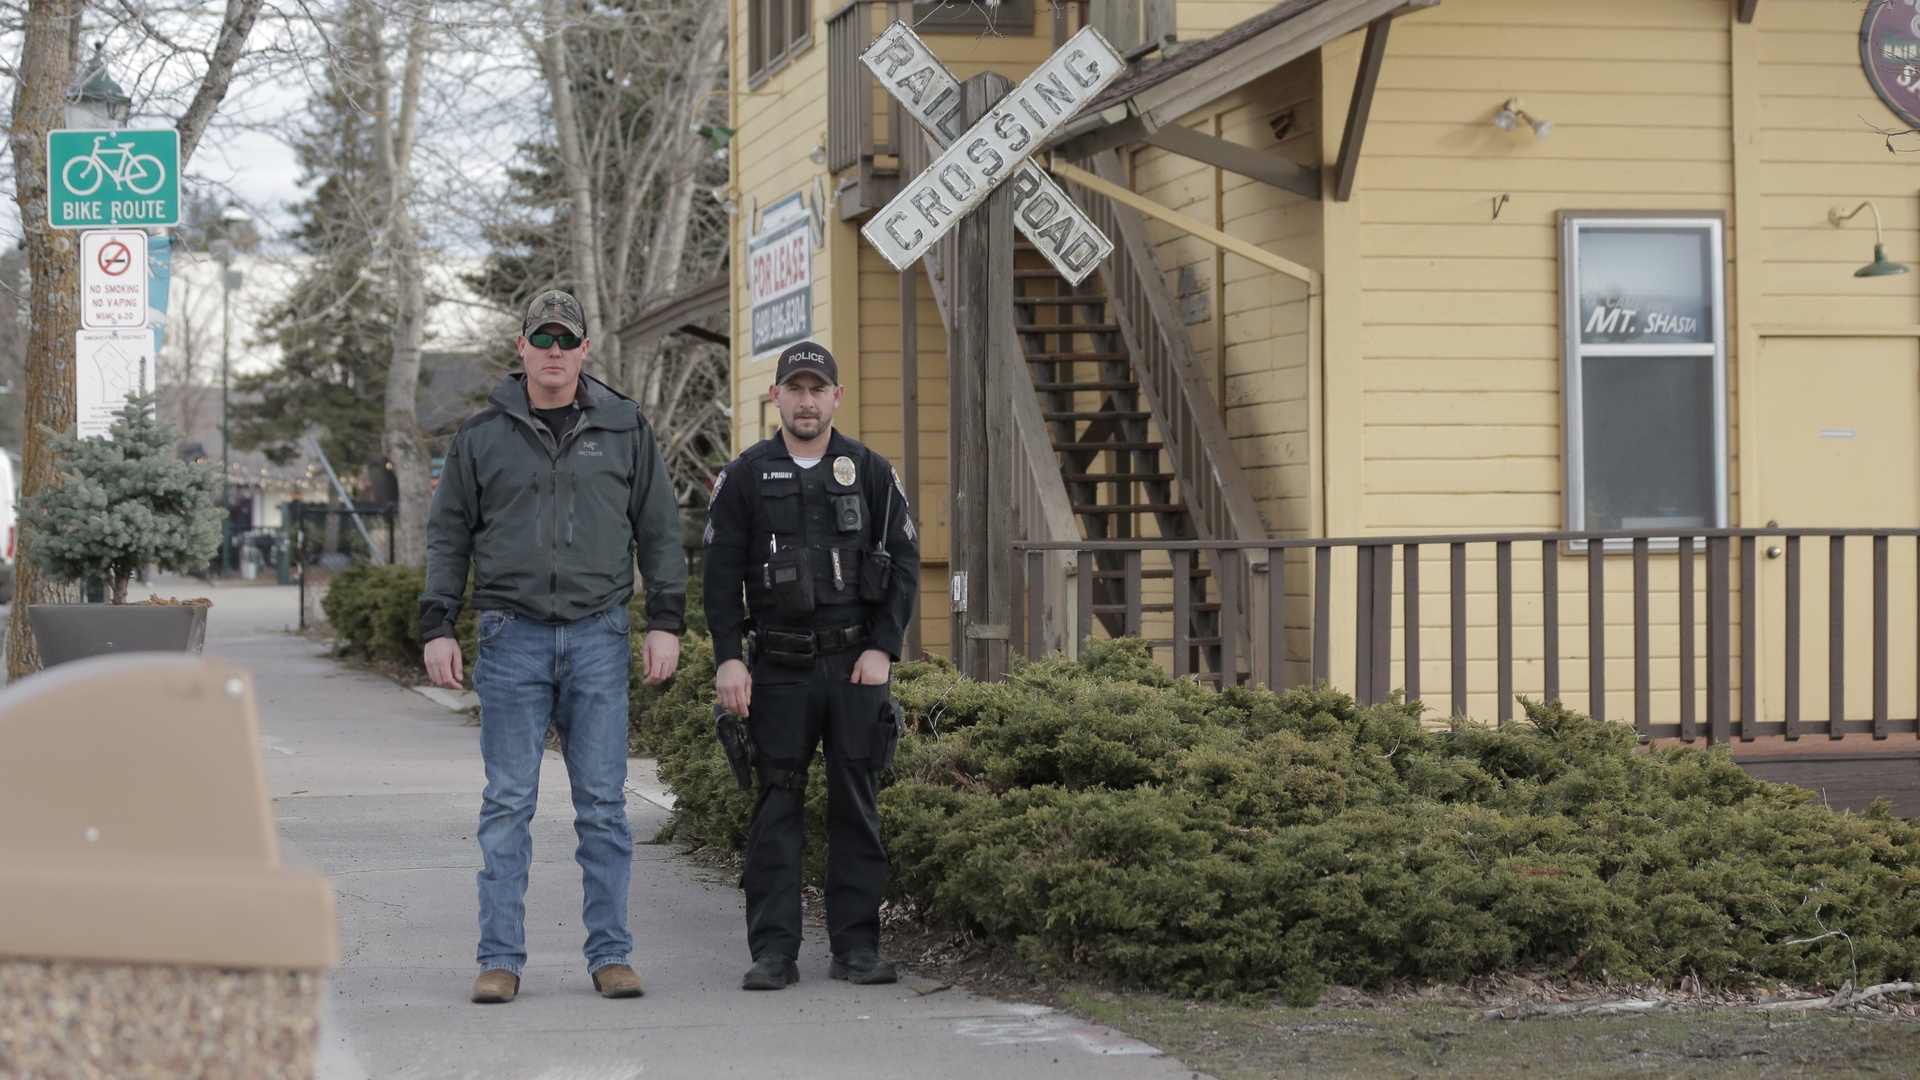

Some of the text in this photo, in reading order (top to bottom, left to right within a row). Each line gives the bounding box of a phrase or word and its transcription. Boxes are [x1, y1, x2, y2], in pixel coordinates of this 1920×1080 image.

[874, 35, 1099, 272] RAIL ROAD
[885, 49, 1101, 250] CROSSING
[63, 200, 166, 220] BIKE ROUTE
[753, 235, 805, 300] FOR LEASE
[89, 285, 140, 294] NO SMOKING
[92, 299, 138, 308] NO VAPING
[1584, 305, 1697, 334] MT. SHASTA
[788, 351, 825, 364] POLICE
